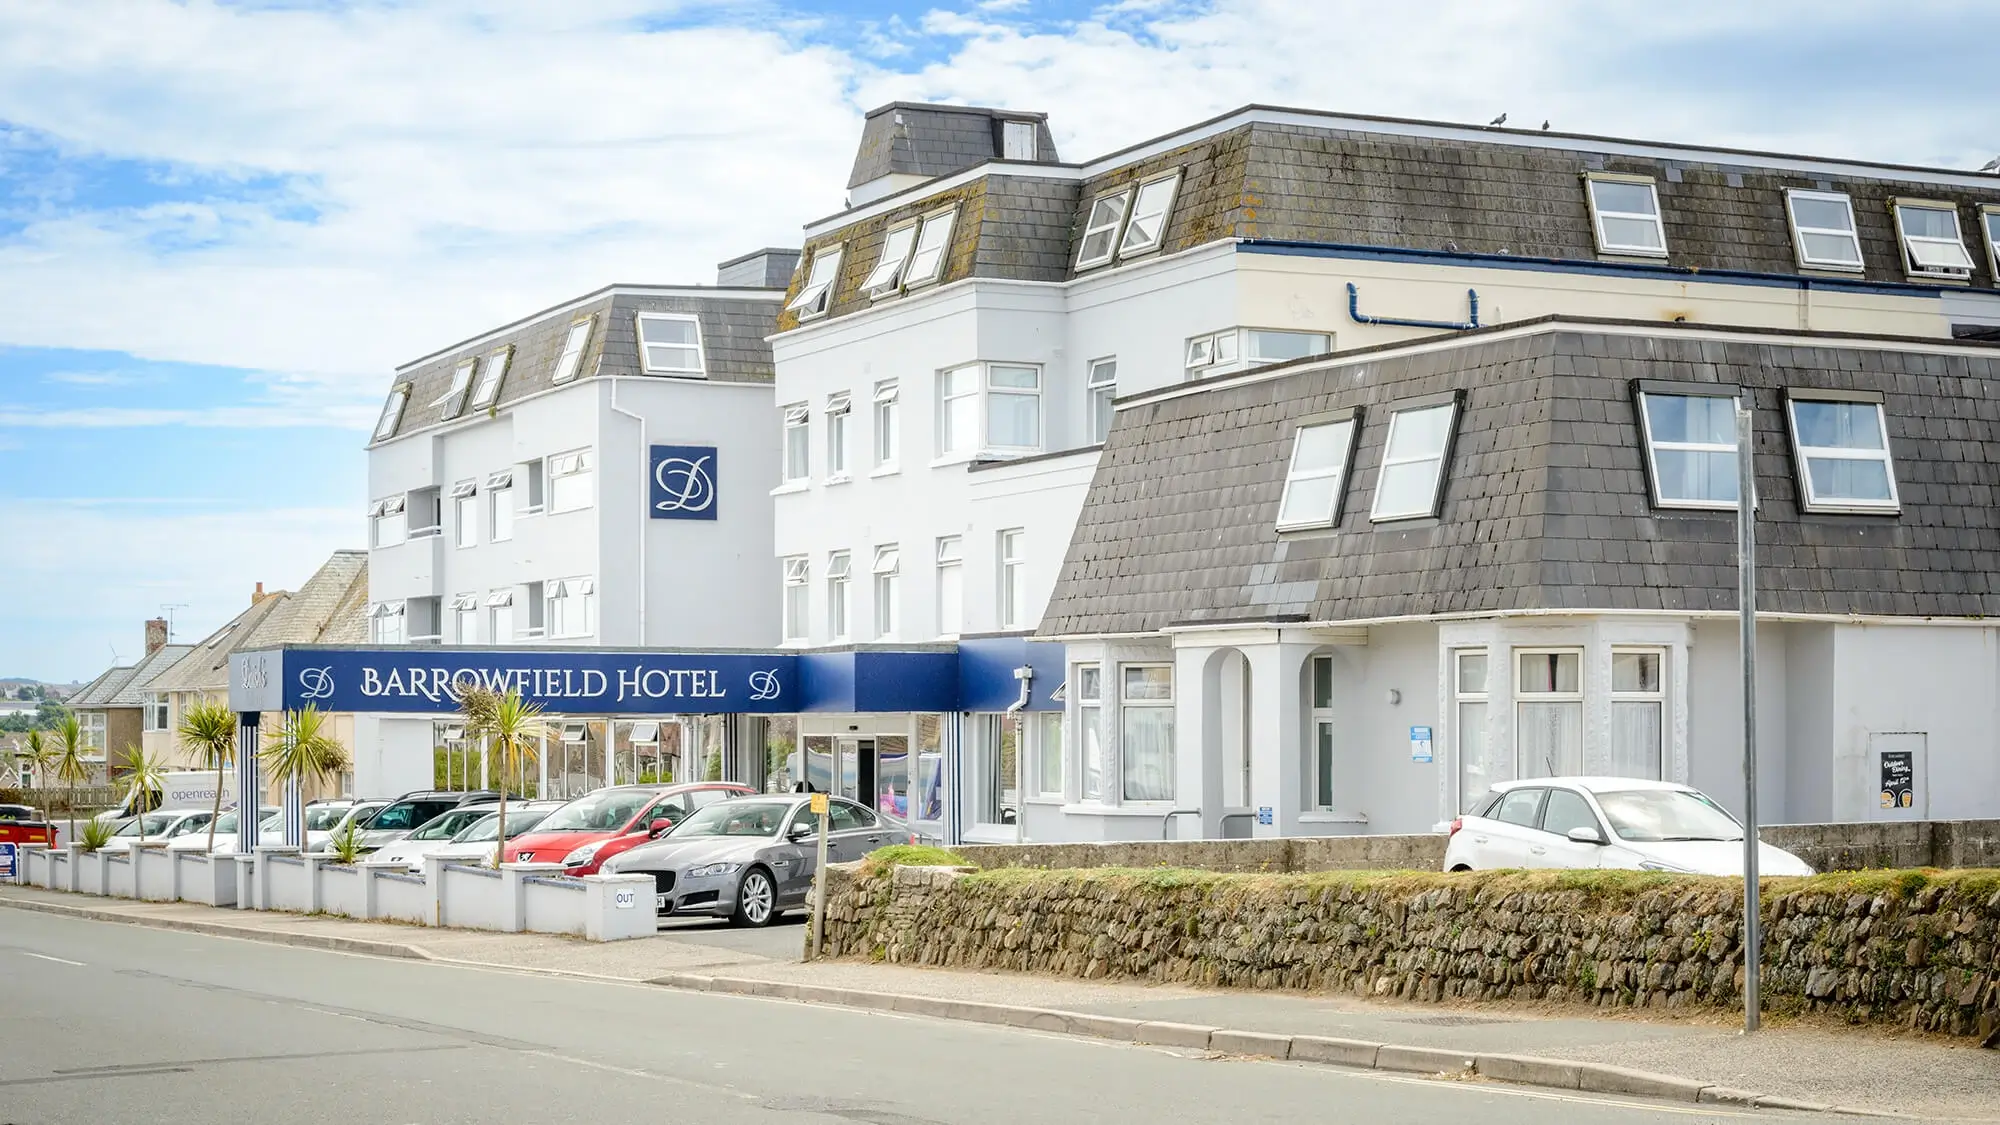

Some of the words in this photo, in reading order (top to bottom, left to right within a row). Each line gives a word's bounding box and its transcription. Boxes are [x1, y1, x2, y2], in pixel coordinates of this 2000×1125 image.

[360, 667, 608, 702] BARROWFIELD
[617, 665, 726, 702] HOTEL
[172, 788, 229, 800] openreah
[616, 893, 634, 903] OUT
